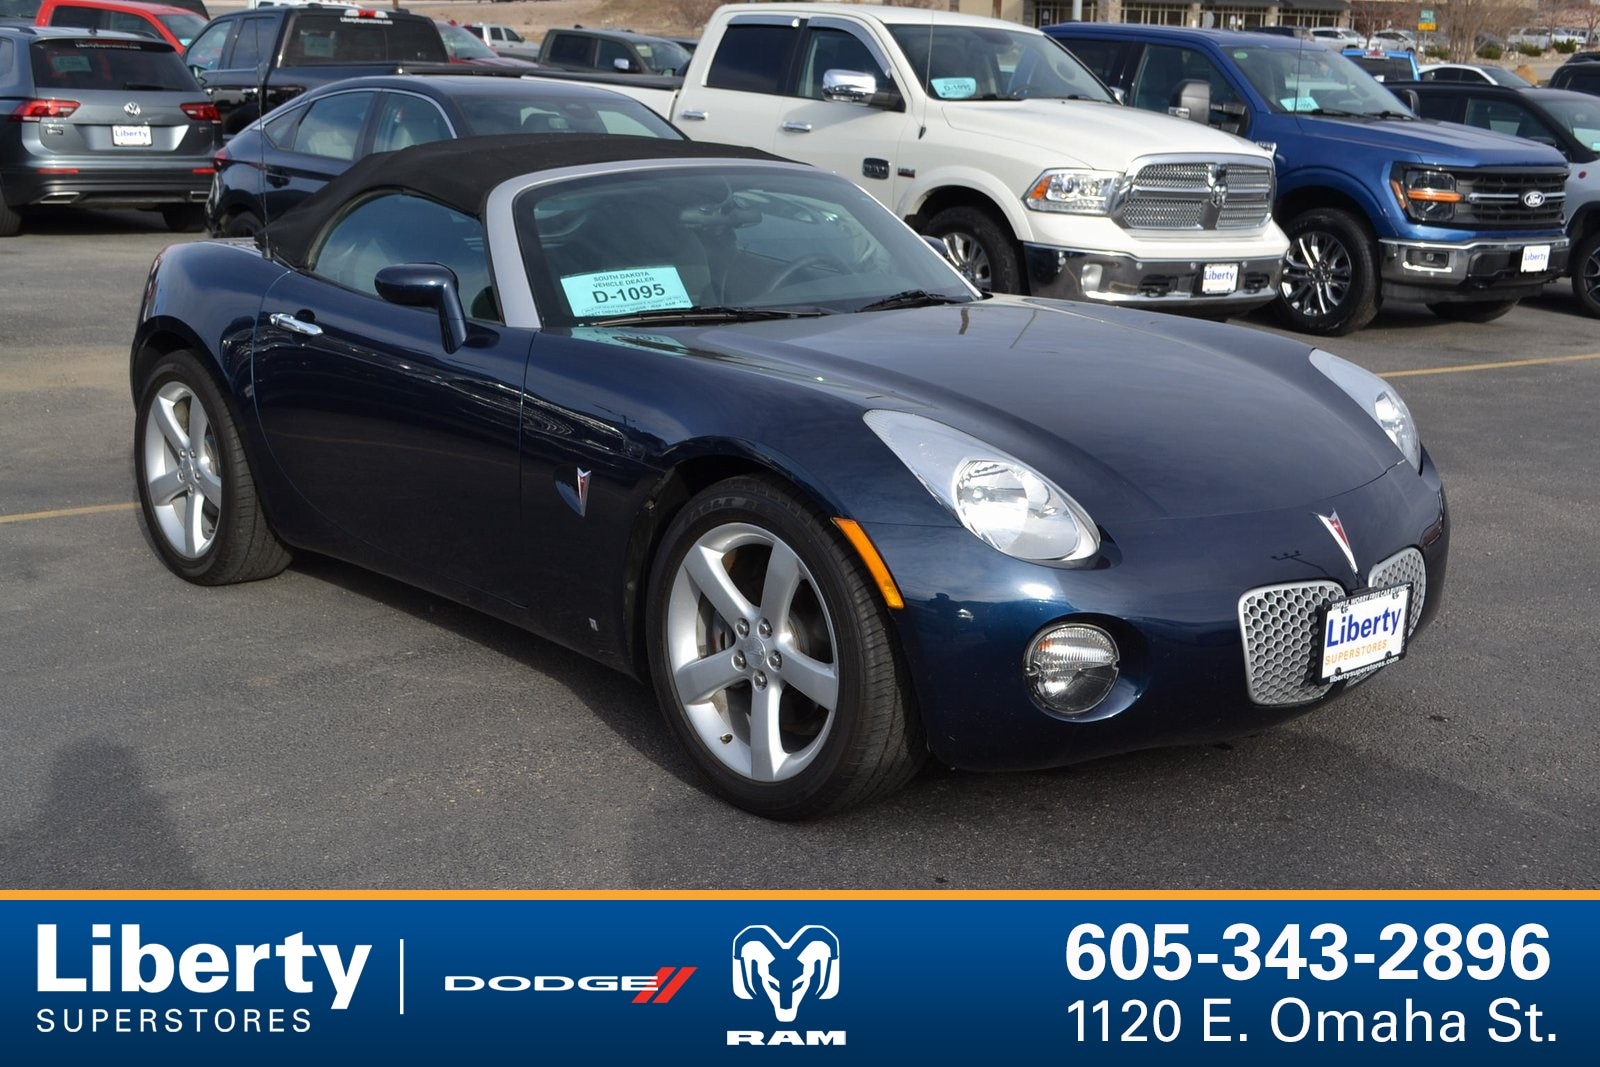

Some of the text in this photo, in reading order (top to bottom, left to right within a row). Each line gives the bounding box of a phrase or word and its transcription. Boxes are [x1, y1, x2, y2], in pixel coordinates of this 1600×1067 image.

[114, 129, 148, 139] Liberty
[1524, 252, 1547, 262] Liberty
[593, 271, 650, 282] SOUTH DAKOTA
[626, 277, 655, 285] DEALER
[1203, 270, 1235, 282] Liberty
[592, 283, 666, 304] D-1095
[1326, 607, 1402, 648] Liberty
[1325, 639, 1388, 665] SUPERSTORES
[1329, 656, 1399, 683] libertysuperstores.com
